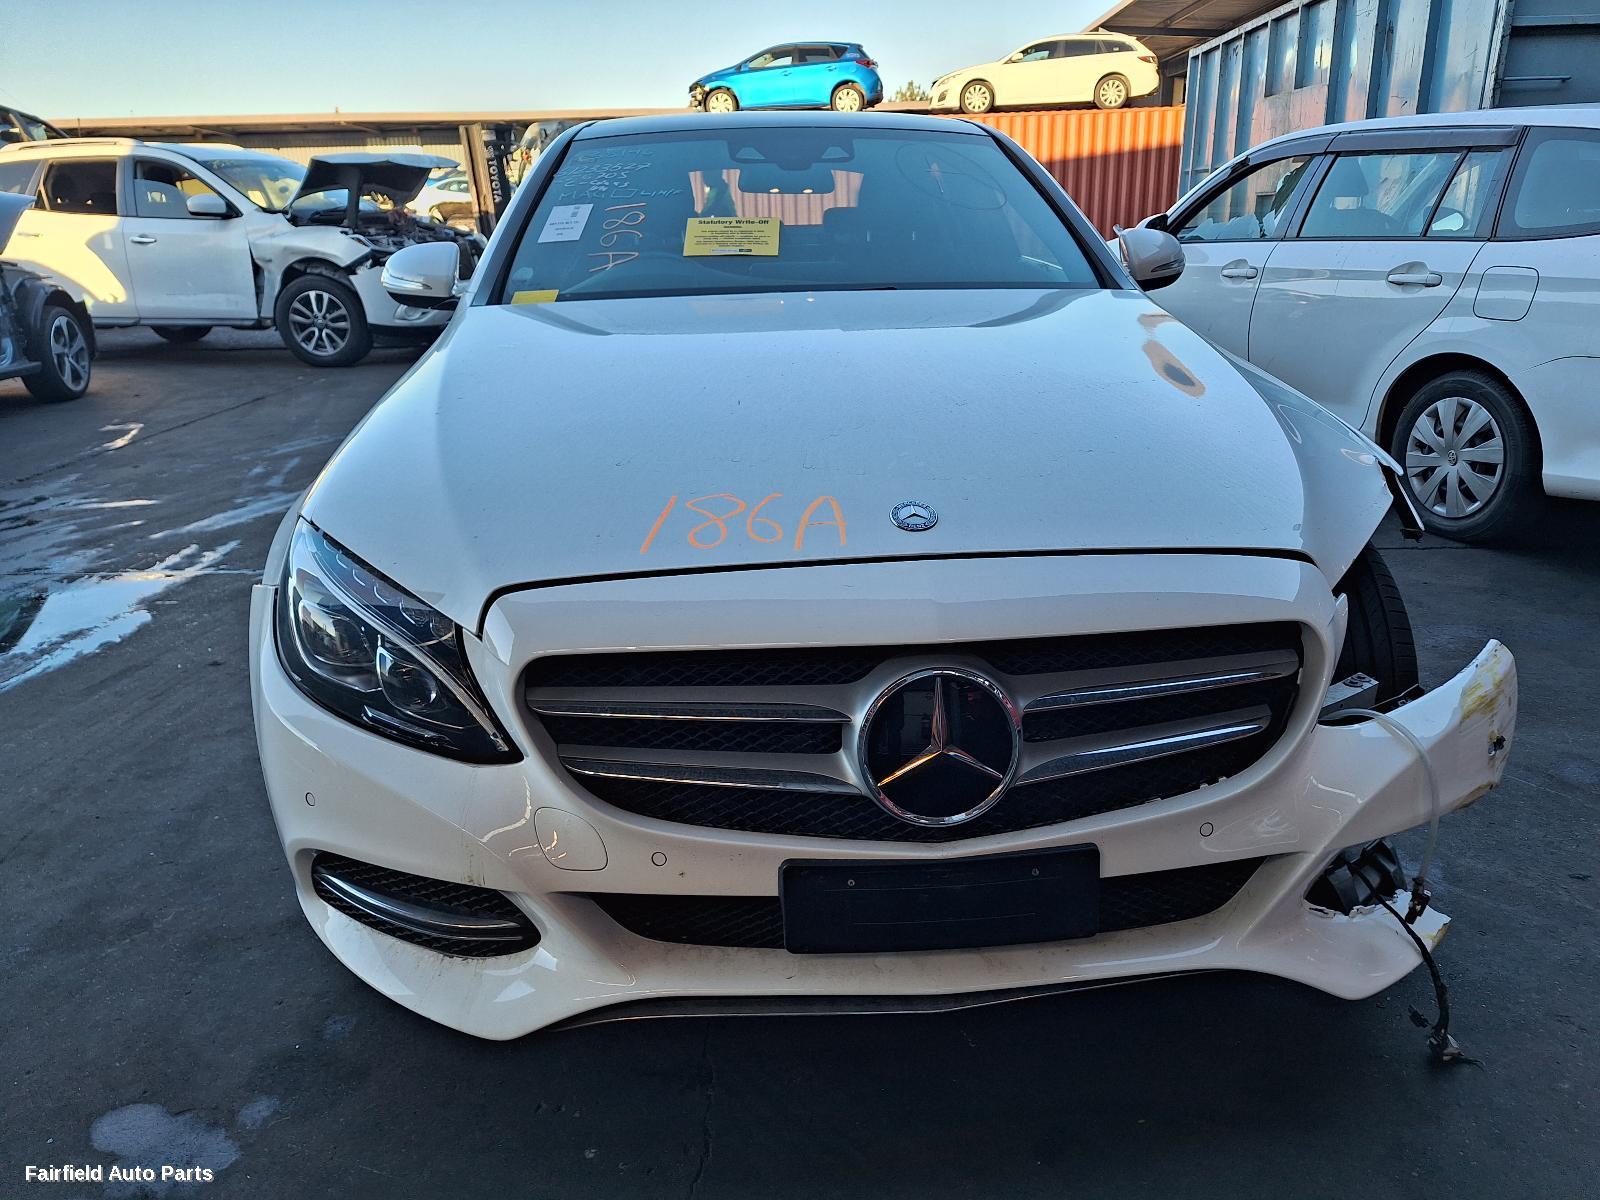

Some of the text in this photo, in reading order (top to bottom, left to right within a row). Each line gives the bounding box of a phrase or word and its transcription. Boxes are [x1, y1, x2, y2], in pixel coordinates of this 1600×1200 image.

[488, 159, 503, 203] TOYOTA
[587, 203, 647, 273] 186A
[640, 493, 847, 554] 186A
